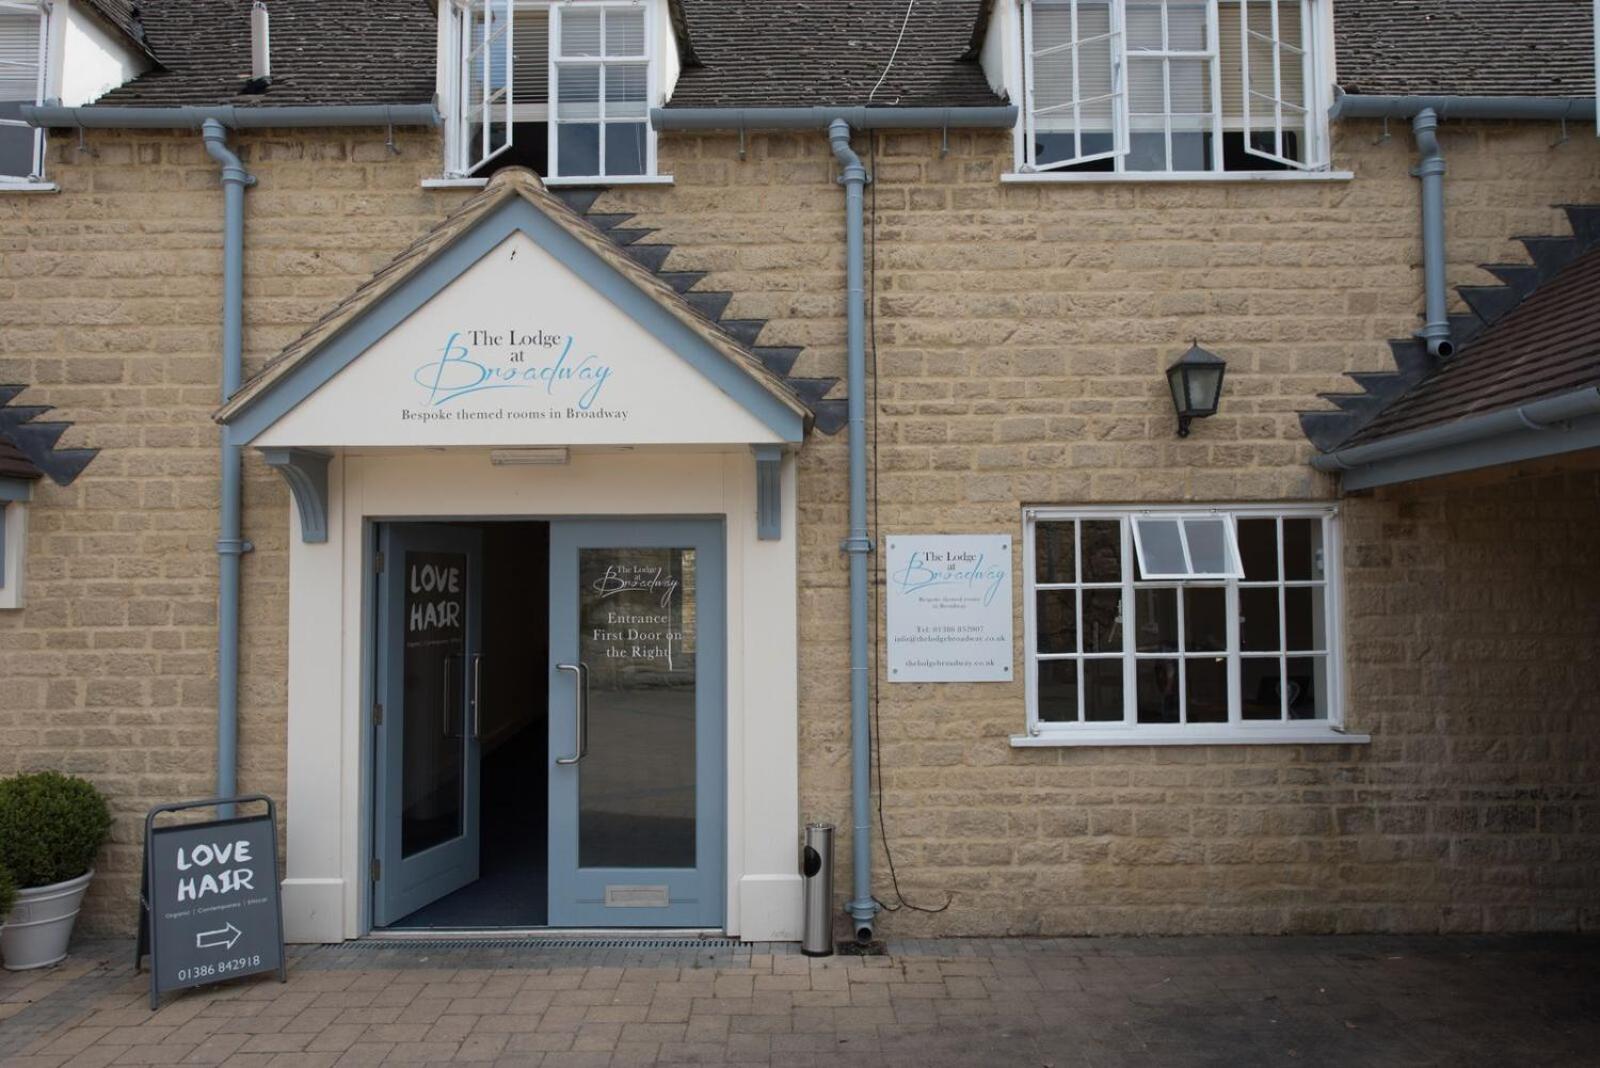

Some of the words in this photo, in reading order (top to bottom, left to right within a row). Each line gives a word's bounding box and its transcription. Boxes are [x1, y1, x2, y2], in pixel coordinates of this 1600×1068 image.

[468, 330, 503, 346] The
[510, 330, 561, 348] Lodge
[510, 351, 525, 362] at
[414, 332, 612, 410] Broadway
[402, 409, 452, 423] Bespoke
[457, 409, 503, 420] themed
[507, 411, 546, 420] rooms
[550, 408, 561, 420] in
[566, 408, 629, 421] Broadway
[923, 551, 943, 561] The
[946, 551, 976, 562] Lodge
[410, 564, 460, 594] LOVE
[892, 552, 1006, 607] Broadway
[409, 600, 460, 632] HAIR
[608, 612, 668, 624] Entrance
[593, 629, 622, 640] First
[628, 629, 661, 640] Door
[606, 646, 627, 657] the
[632, 646, 668, 660] Right
[177, 840, 253, 871] LOVE
[177, 868, 255, 901] HAIR
[178, 963, 216, 981] 01386
[218, 955, 261, 973] 842918
